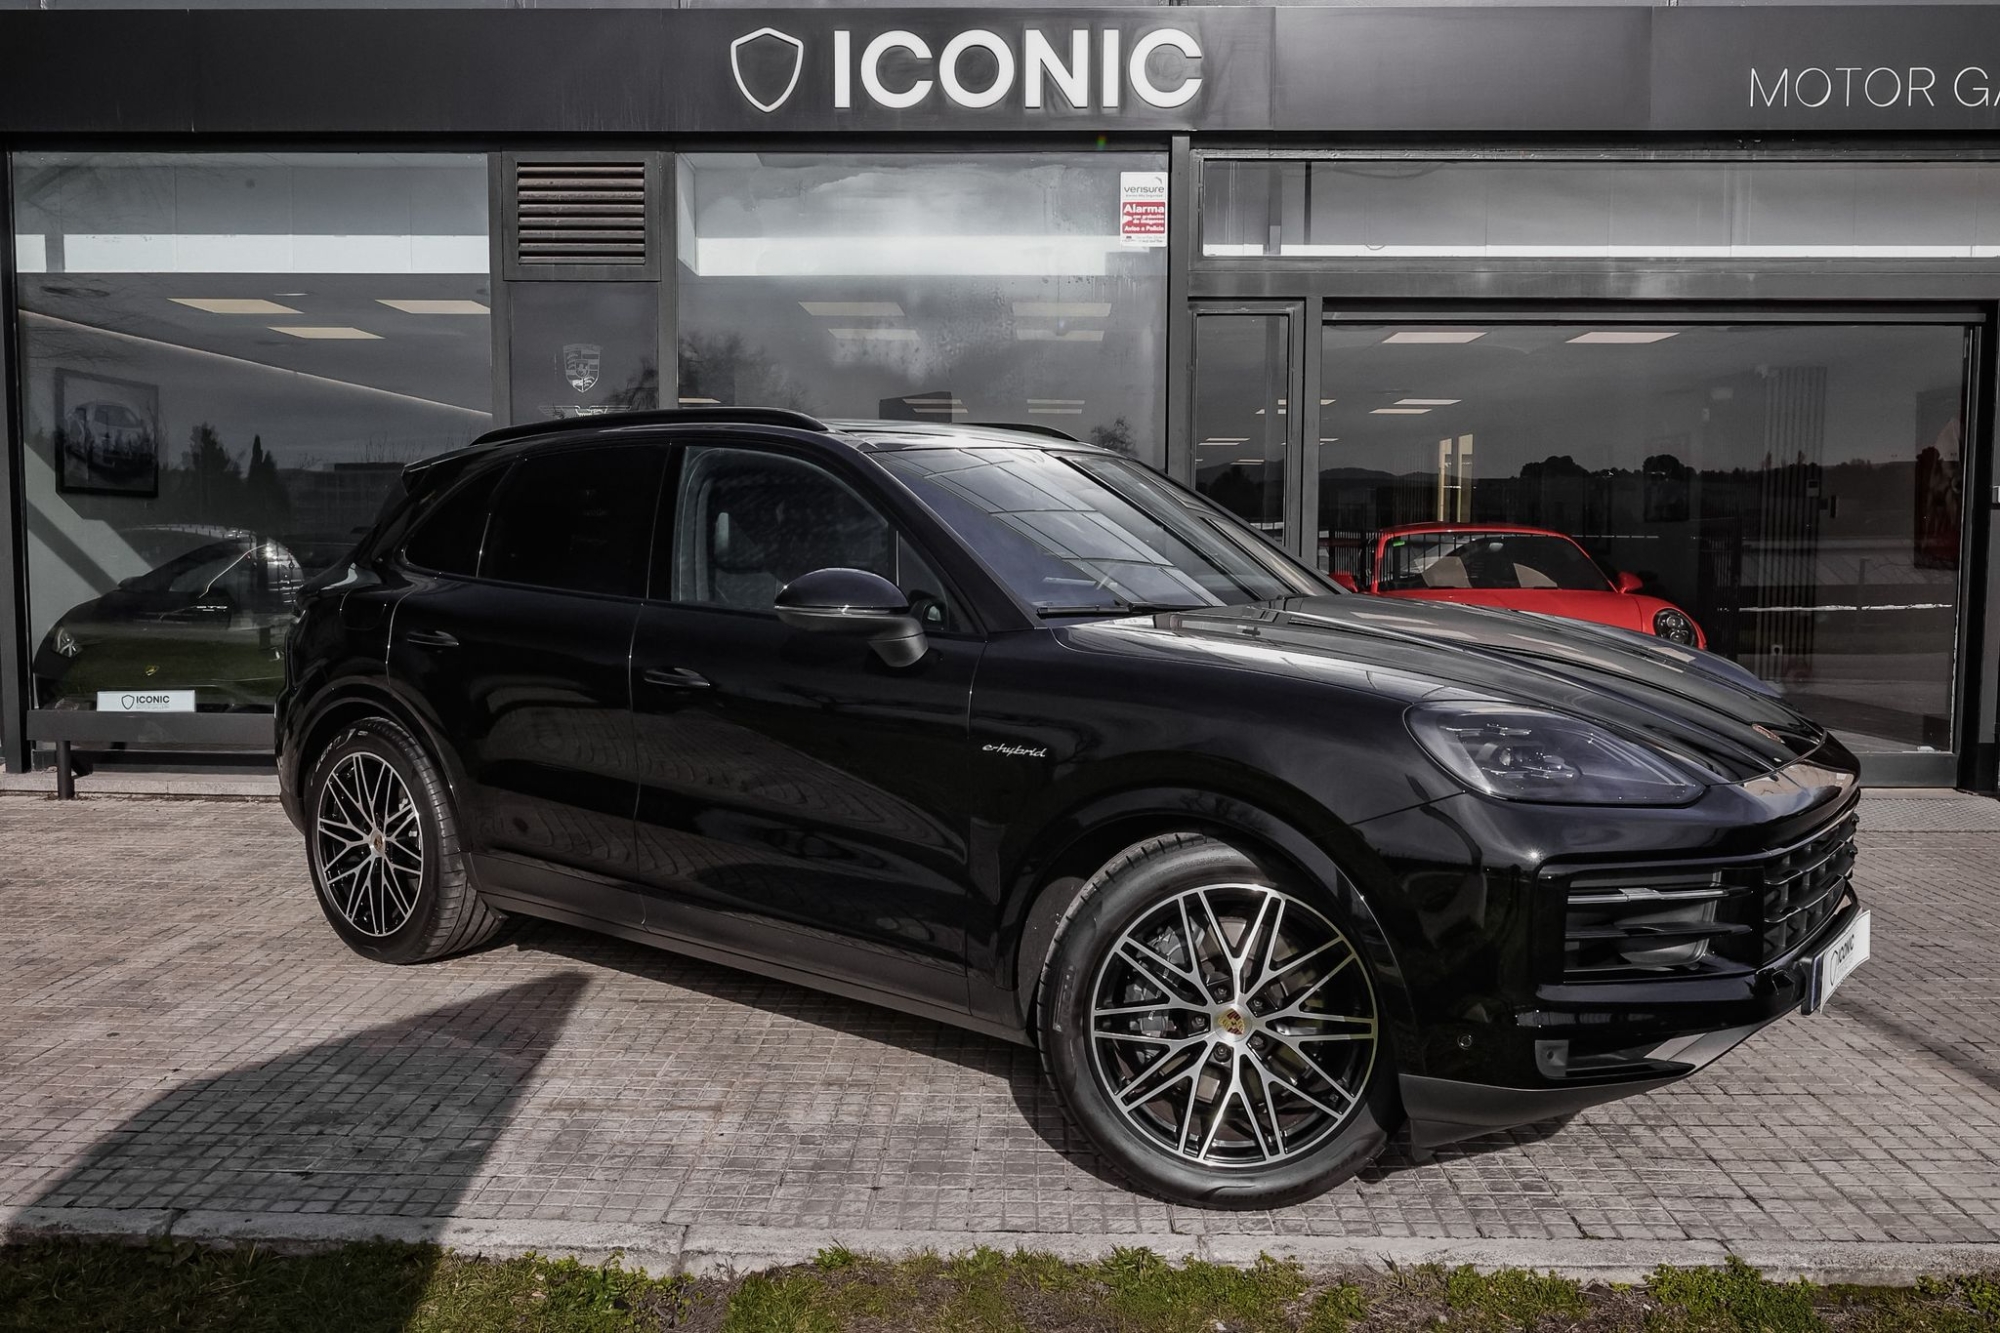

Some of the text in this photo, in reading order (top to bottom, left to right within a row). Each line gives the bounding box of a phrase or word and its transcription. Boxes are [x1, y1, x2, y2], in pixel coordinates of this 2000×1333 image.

[834, 28, 1203, 109] ICONIC
[1750, 66, 2000, 108] MOTOR G
[1123, 204, 1164, 213] Alarma
[136, 695, 170, 704] ICONIC
[982, 743, 1048, 758] e-hybrid
